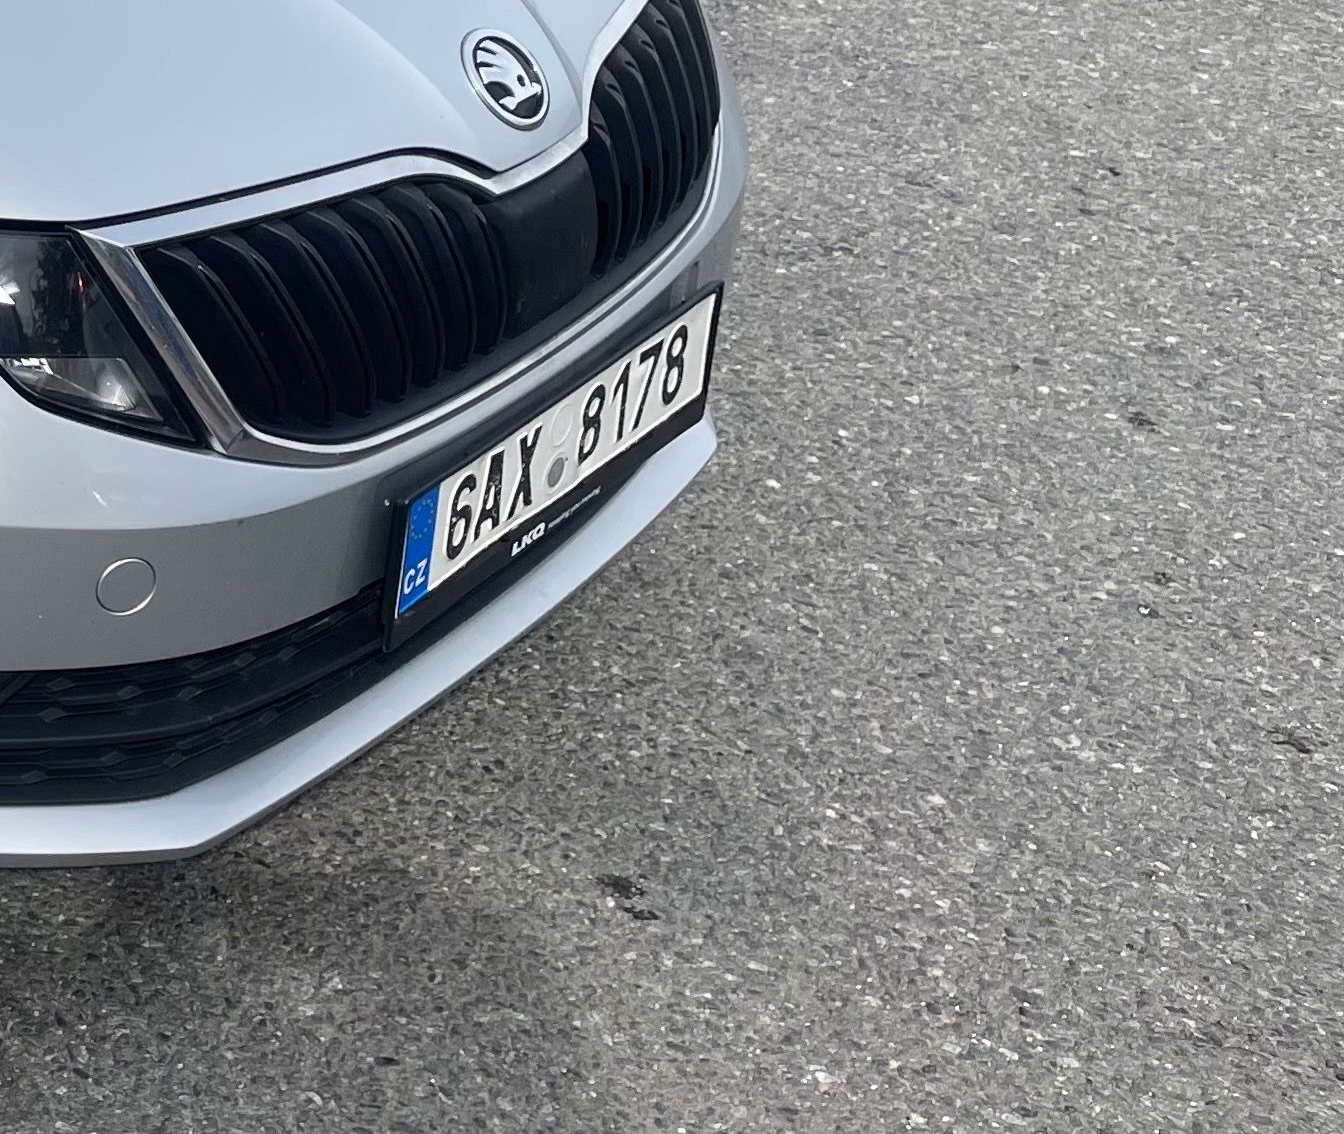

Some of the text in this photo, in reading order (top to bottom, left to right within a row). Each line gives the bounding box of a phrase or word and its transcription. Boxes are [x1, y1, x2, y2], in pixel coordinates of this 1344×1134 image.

[446, 324, 689, 560] 6AX 8178
[511, 522, 546, 557] LKQ
[402, 559, 429, 595] CZ
